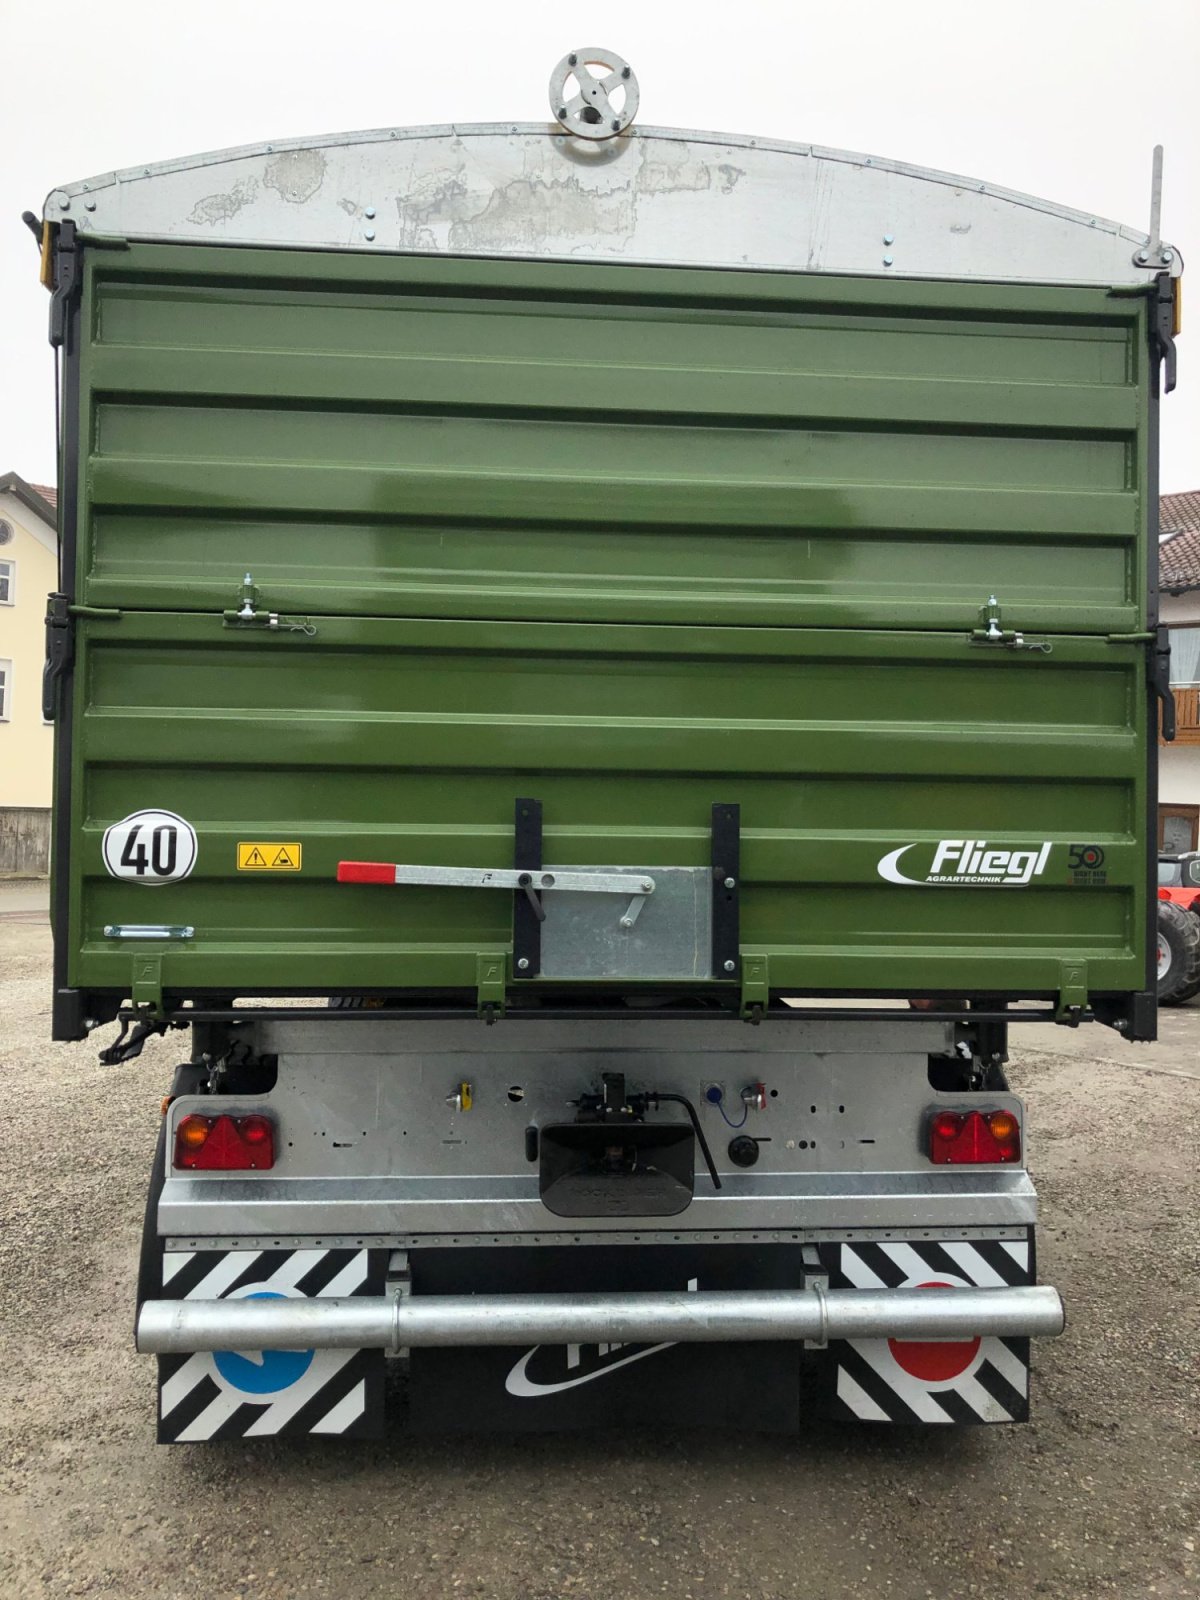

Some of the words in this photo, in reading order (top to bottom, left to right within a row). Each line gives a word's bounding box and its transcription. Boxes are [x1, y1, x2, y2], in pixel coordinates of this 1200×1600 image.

[120, 825, 178, 876] 40
[929, 840, 1053, 884] Fliegl
[925, 875, 1002, 884] AGRARTECHNIK
